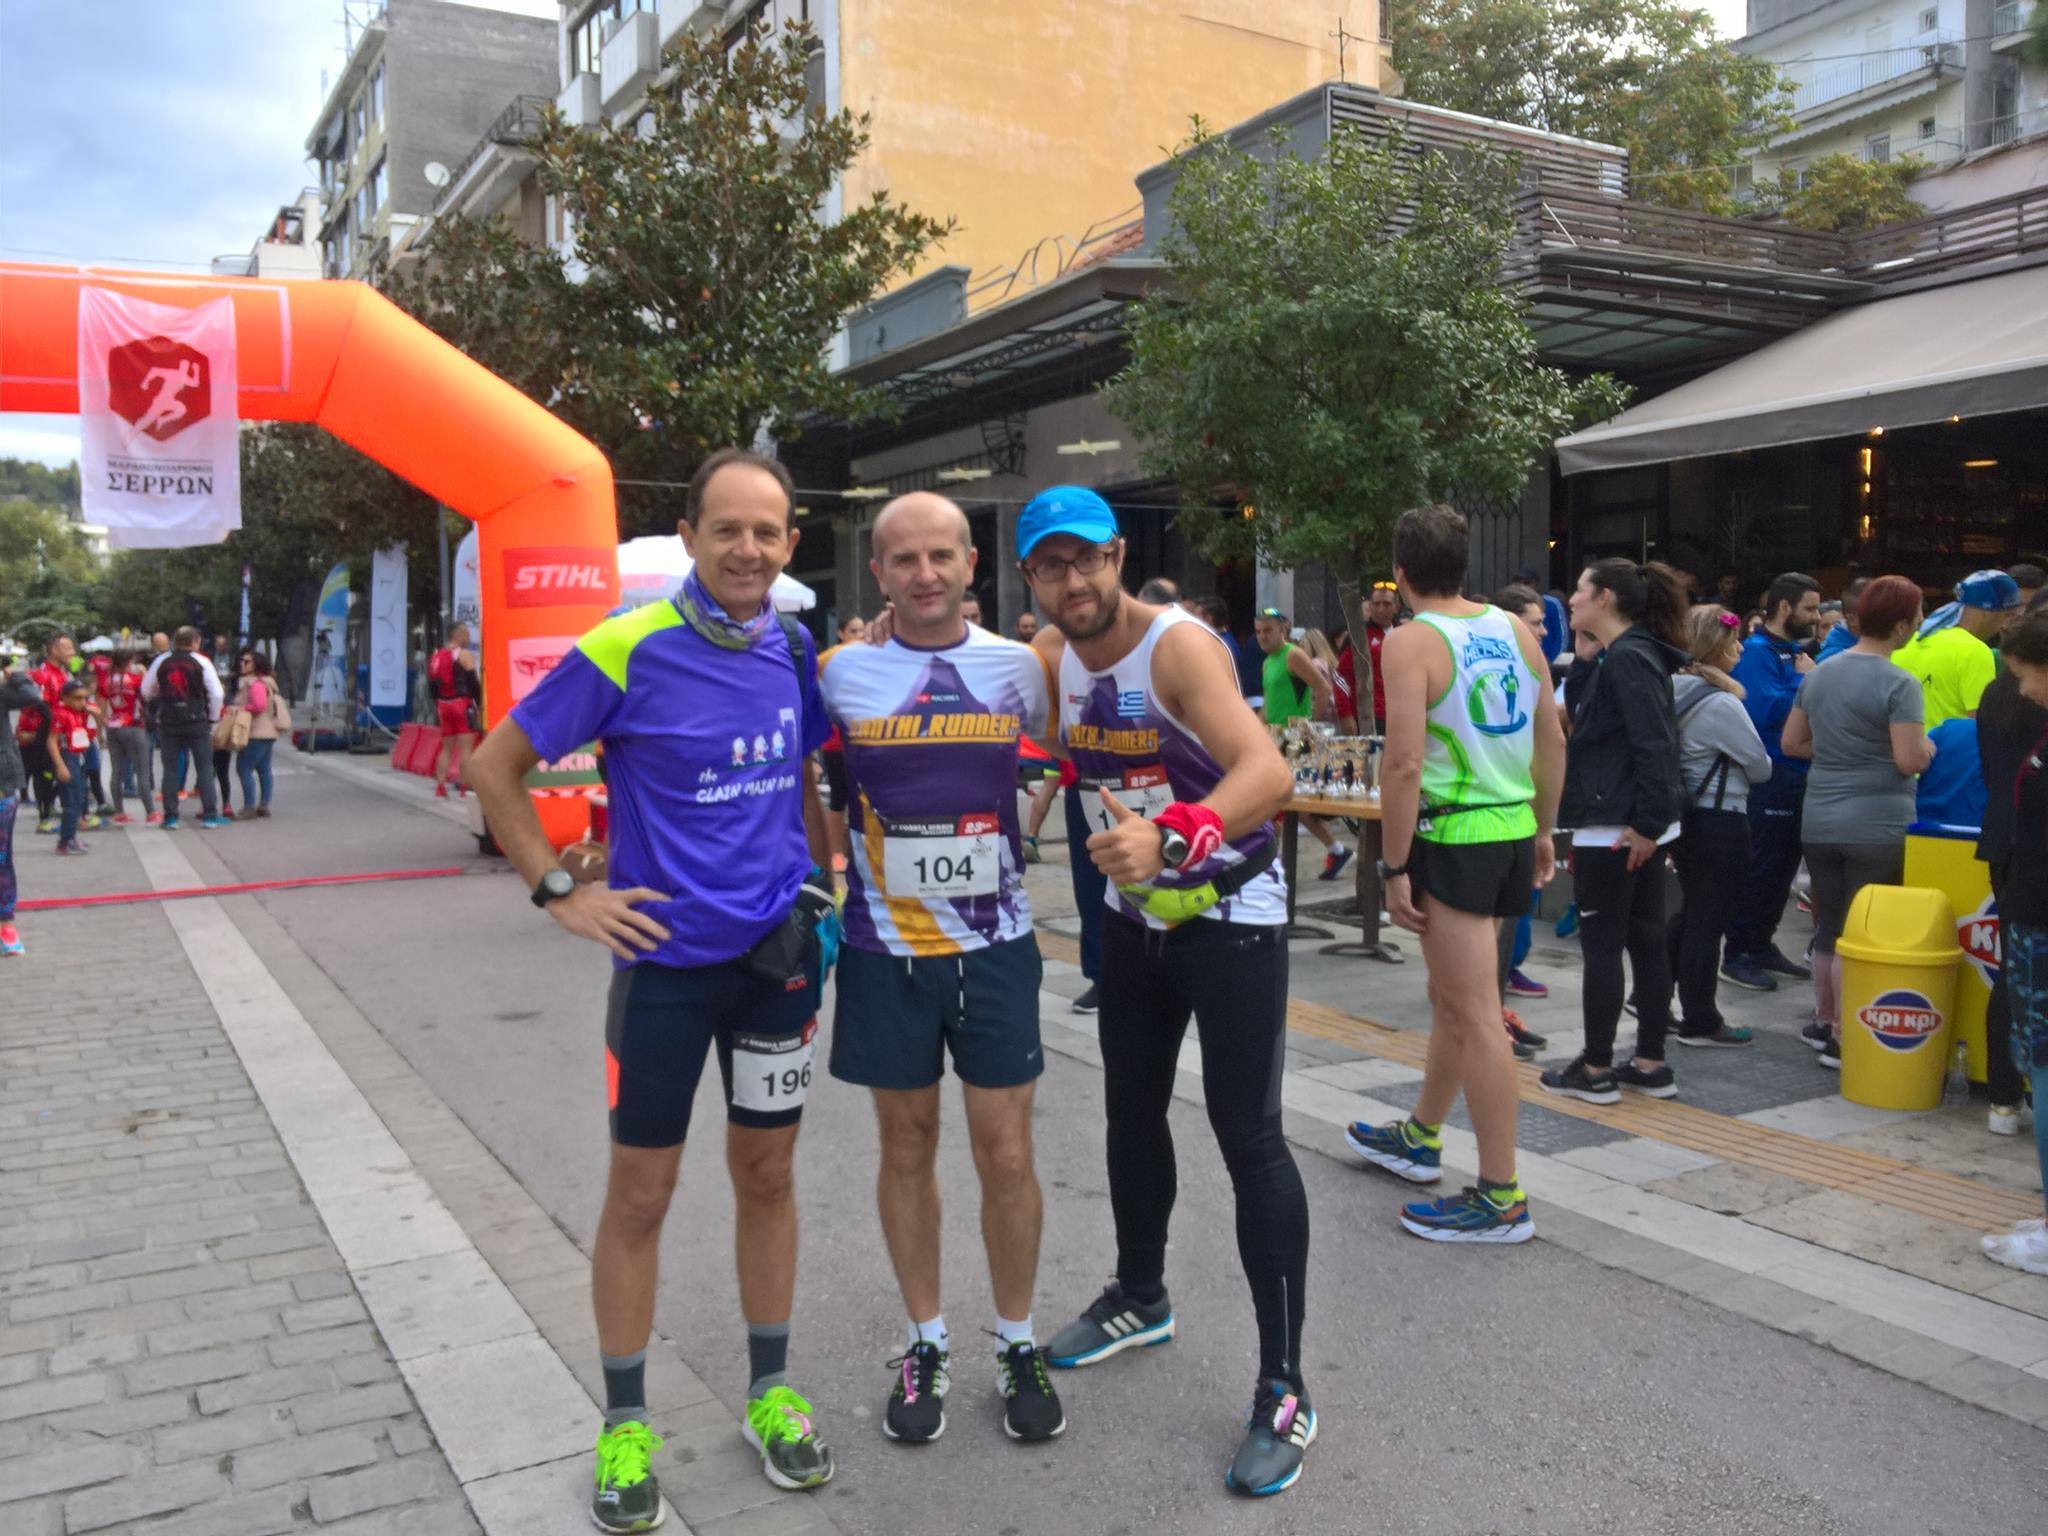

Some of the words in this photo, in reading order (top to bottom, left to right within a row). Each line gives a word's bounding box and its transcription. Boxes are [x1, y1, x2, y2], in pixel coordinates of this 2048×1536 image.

[107, 471, 213, 495] ΣΕΡΡΩΝ
[513, 564, 608, 590] STIHL
[913, 854, 975, 884] 104
[761, 1061, 812, 1098] 196
